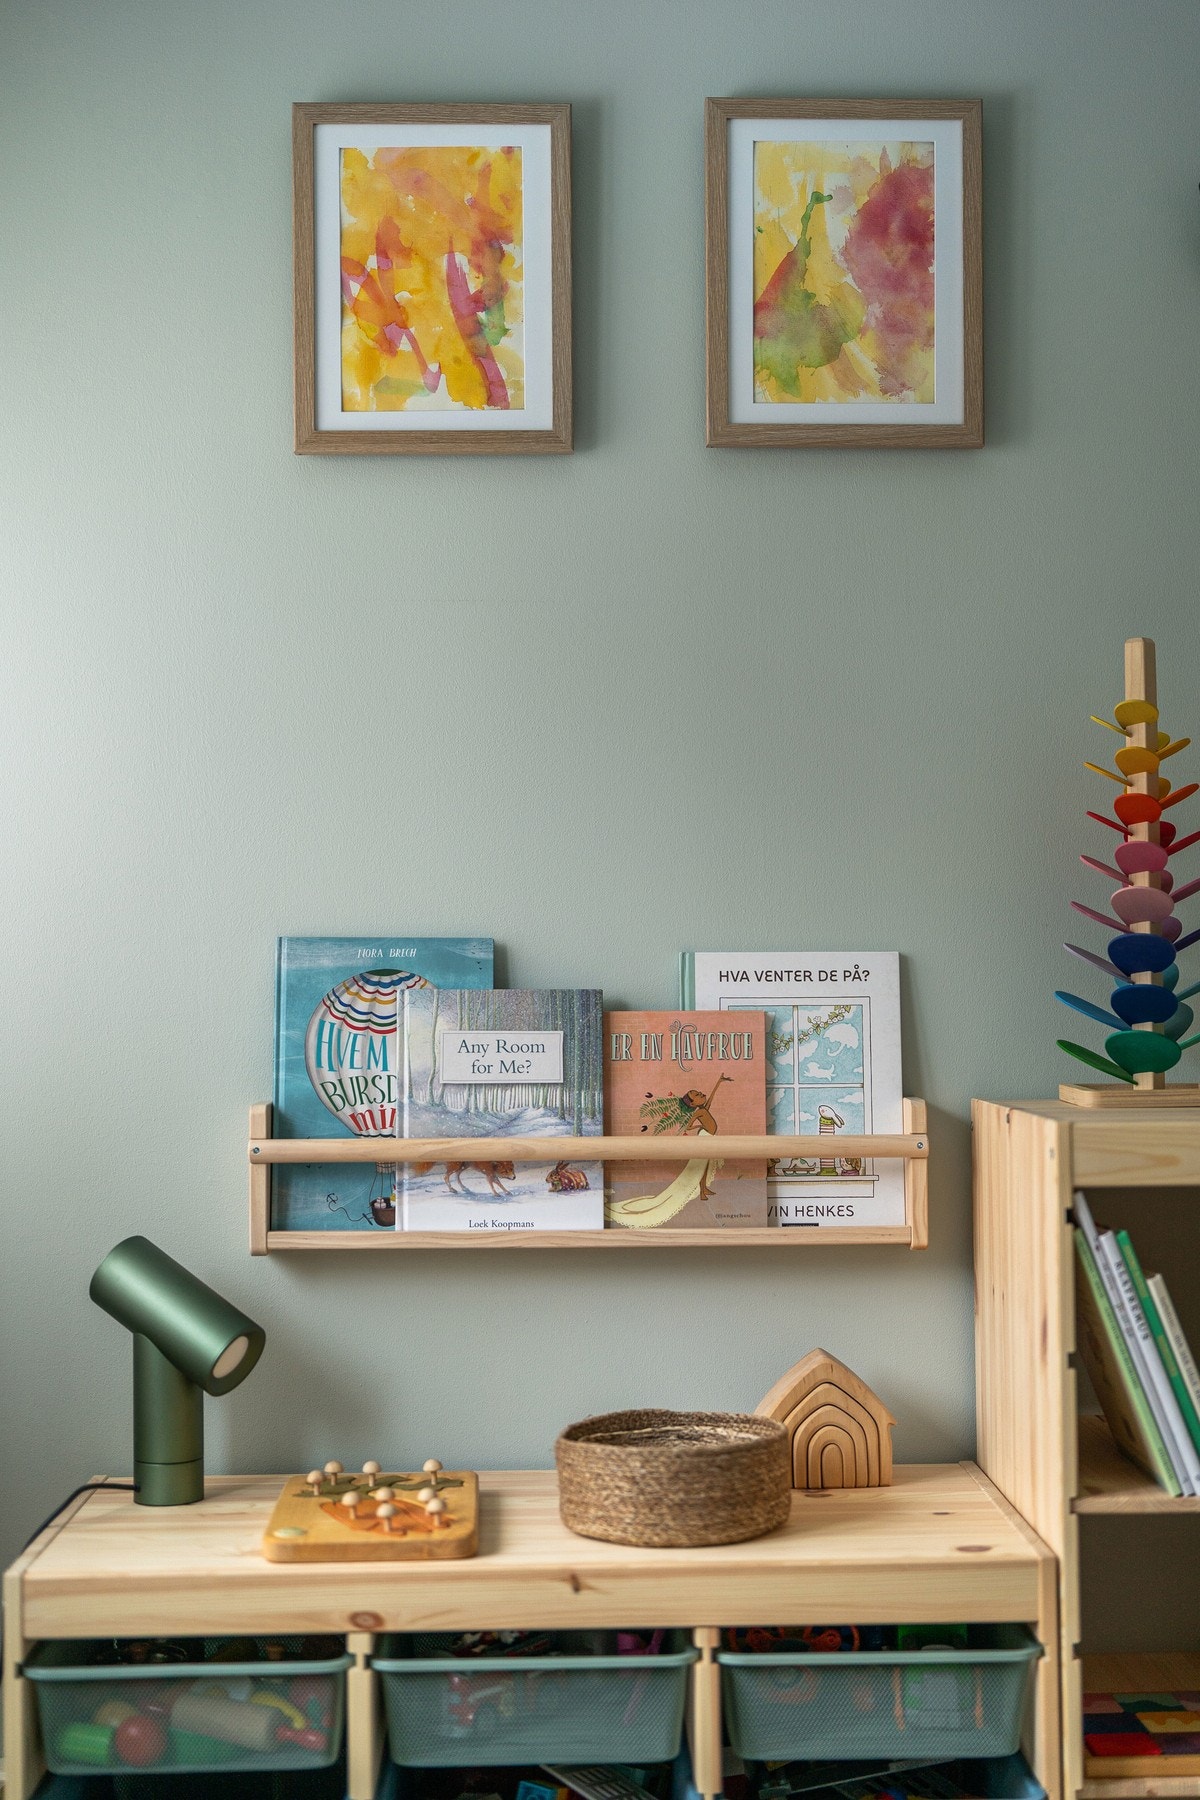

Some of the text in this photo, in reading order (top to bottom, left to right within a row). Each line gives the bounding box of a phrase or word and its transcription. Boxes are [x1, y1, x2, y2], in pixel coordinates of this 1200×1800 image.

[357, 948, 417, 959] NORA BRECH
[719, 964, 870, 982] HVA VENTER DE PÅ?
[315, 1018, 389, 1072] HVEM
[457, 1039, 546, 1057] Any Room
[610, 1021, 754, 1072] ER EN HAVFRUE
[471, 1059, 532, 1074] for Me?
[795, 1205, 855, 1217] HENKES
[469, 1219, 535, 1231] Loek Koopmans
